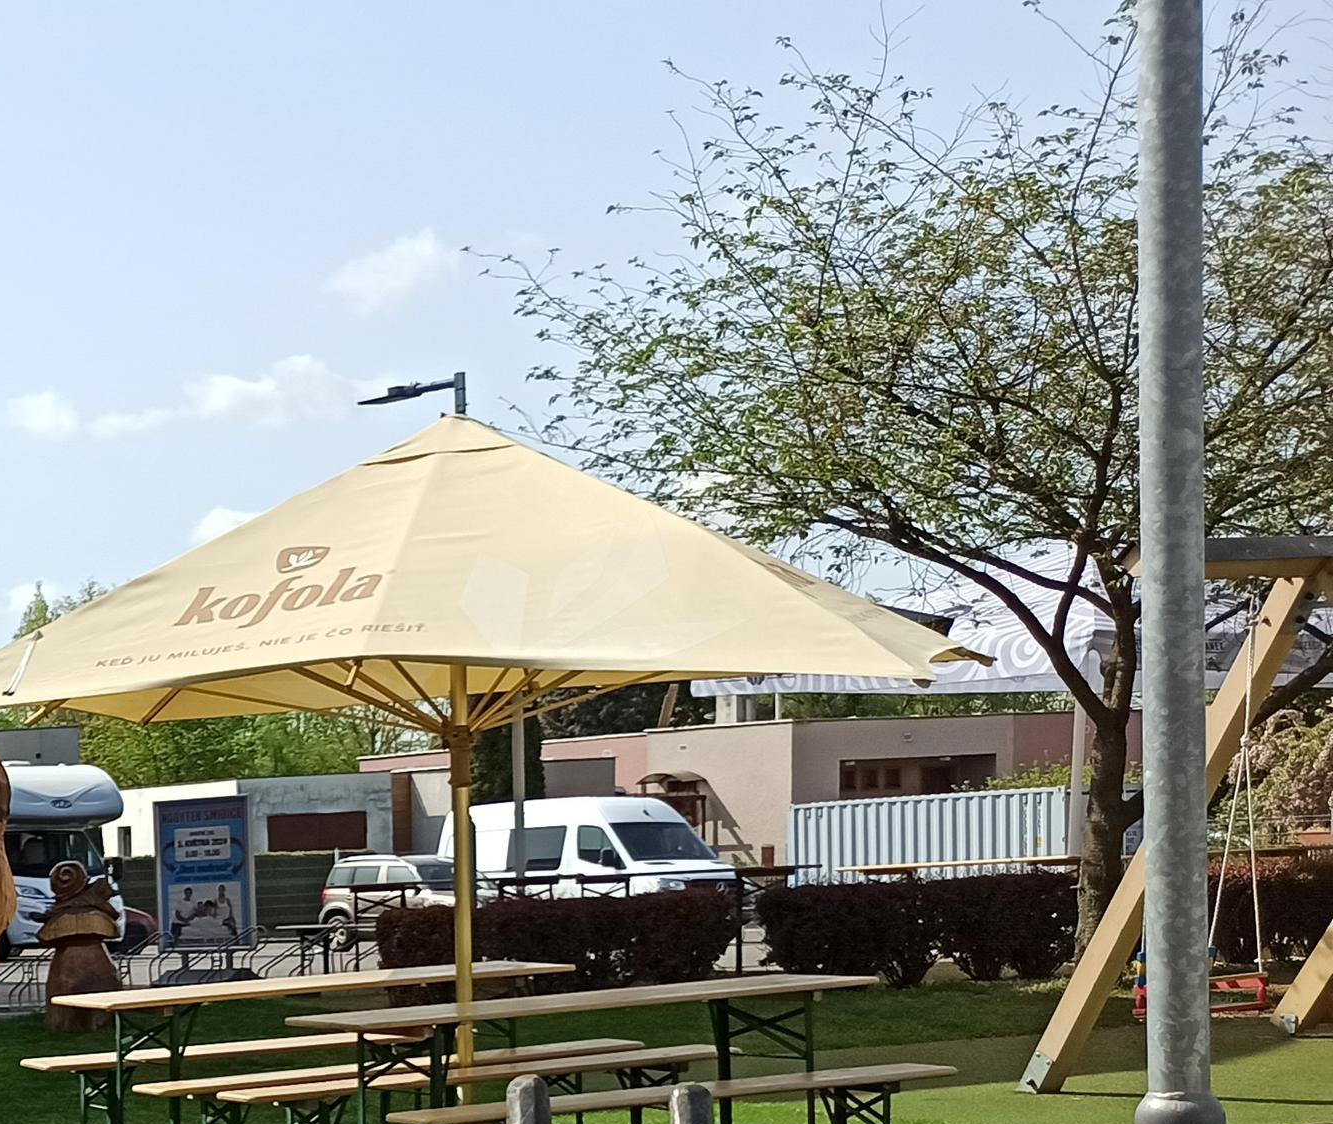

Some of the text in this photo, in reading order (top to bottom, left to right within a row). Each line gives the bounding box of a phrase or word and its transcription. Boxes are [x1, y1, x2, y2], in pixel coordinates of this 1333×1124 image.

[174, 567, 383, 629] kofola
[138, 654, 161, 665] JU
[259, 636, 291, 648] NIE
[294, 633, 318, 644] JE
[325, 627, 353, 638] ČO
